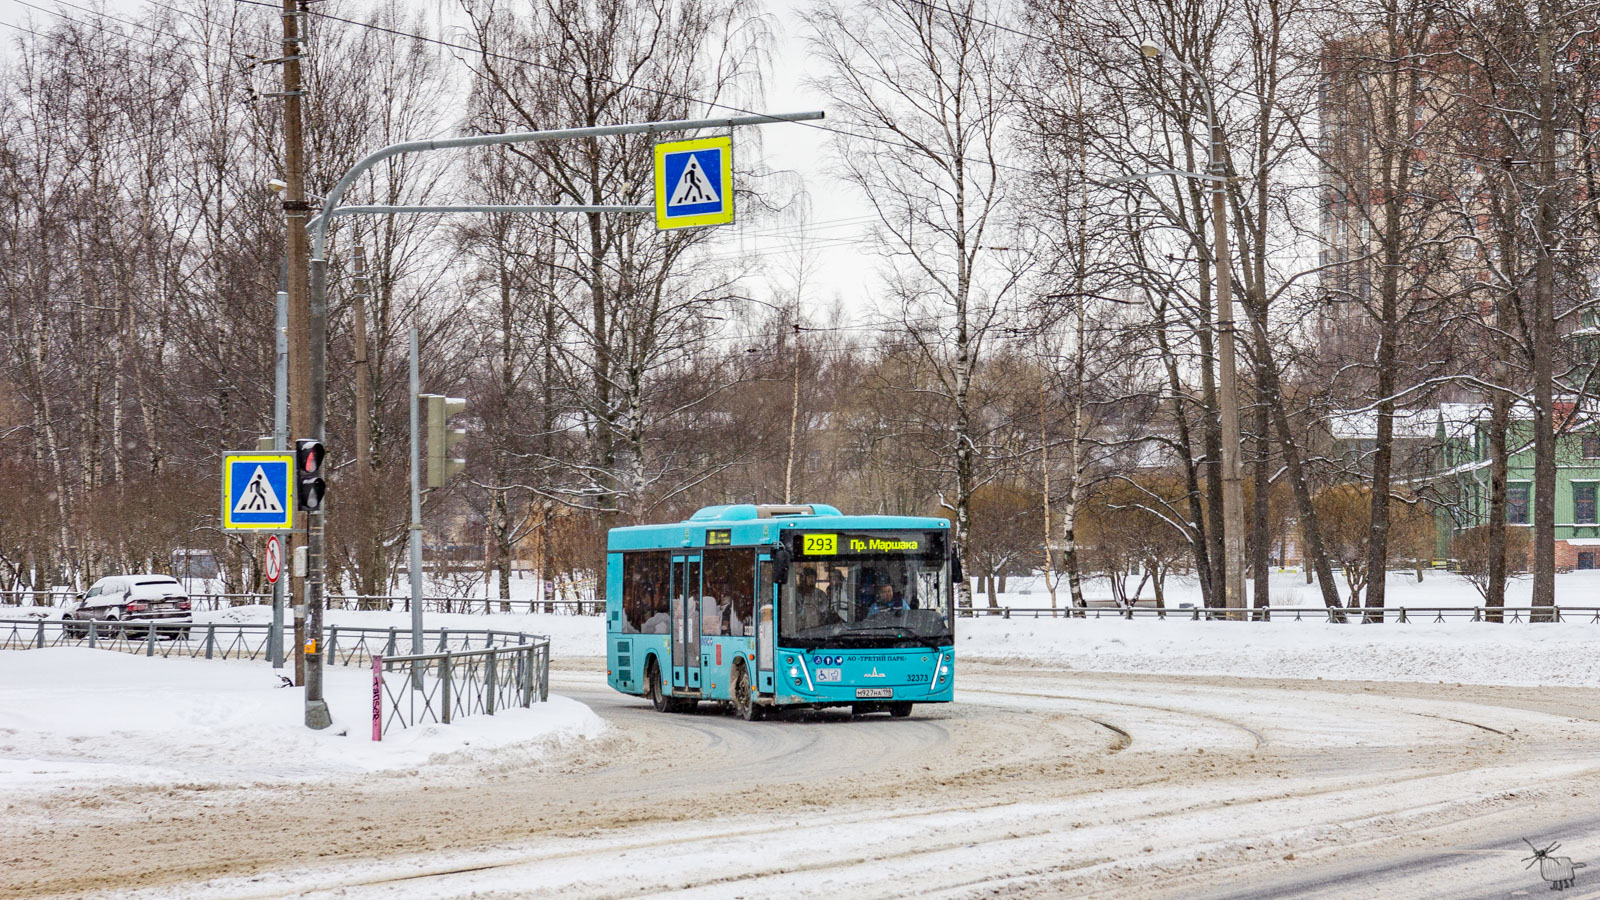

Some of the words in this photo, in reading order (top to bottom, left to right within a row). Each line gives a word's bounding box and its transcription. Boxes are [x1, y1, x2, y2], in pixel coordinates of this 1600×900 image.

[807, 538, 833, 551] 293
[850, 539, 867, 552] Пр.
[869, 539, 918, 552] Маршака
[907, 674, 928, 682] 32373
